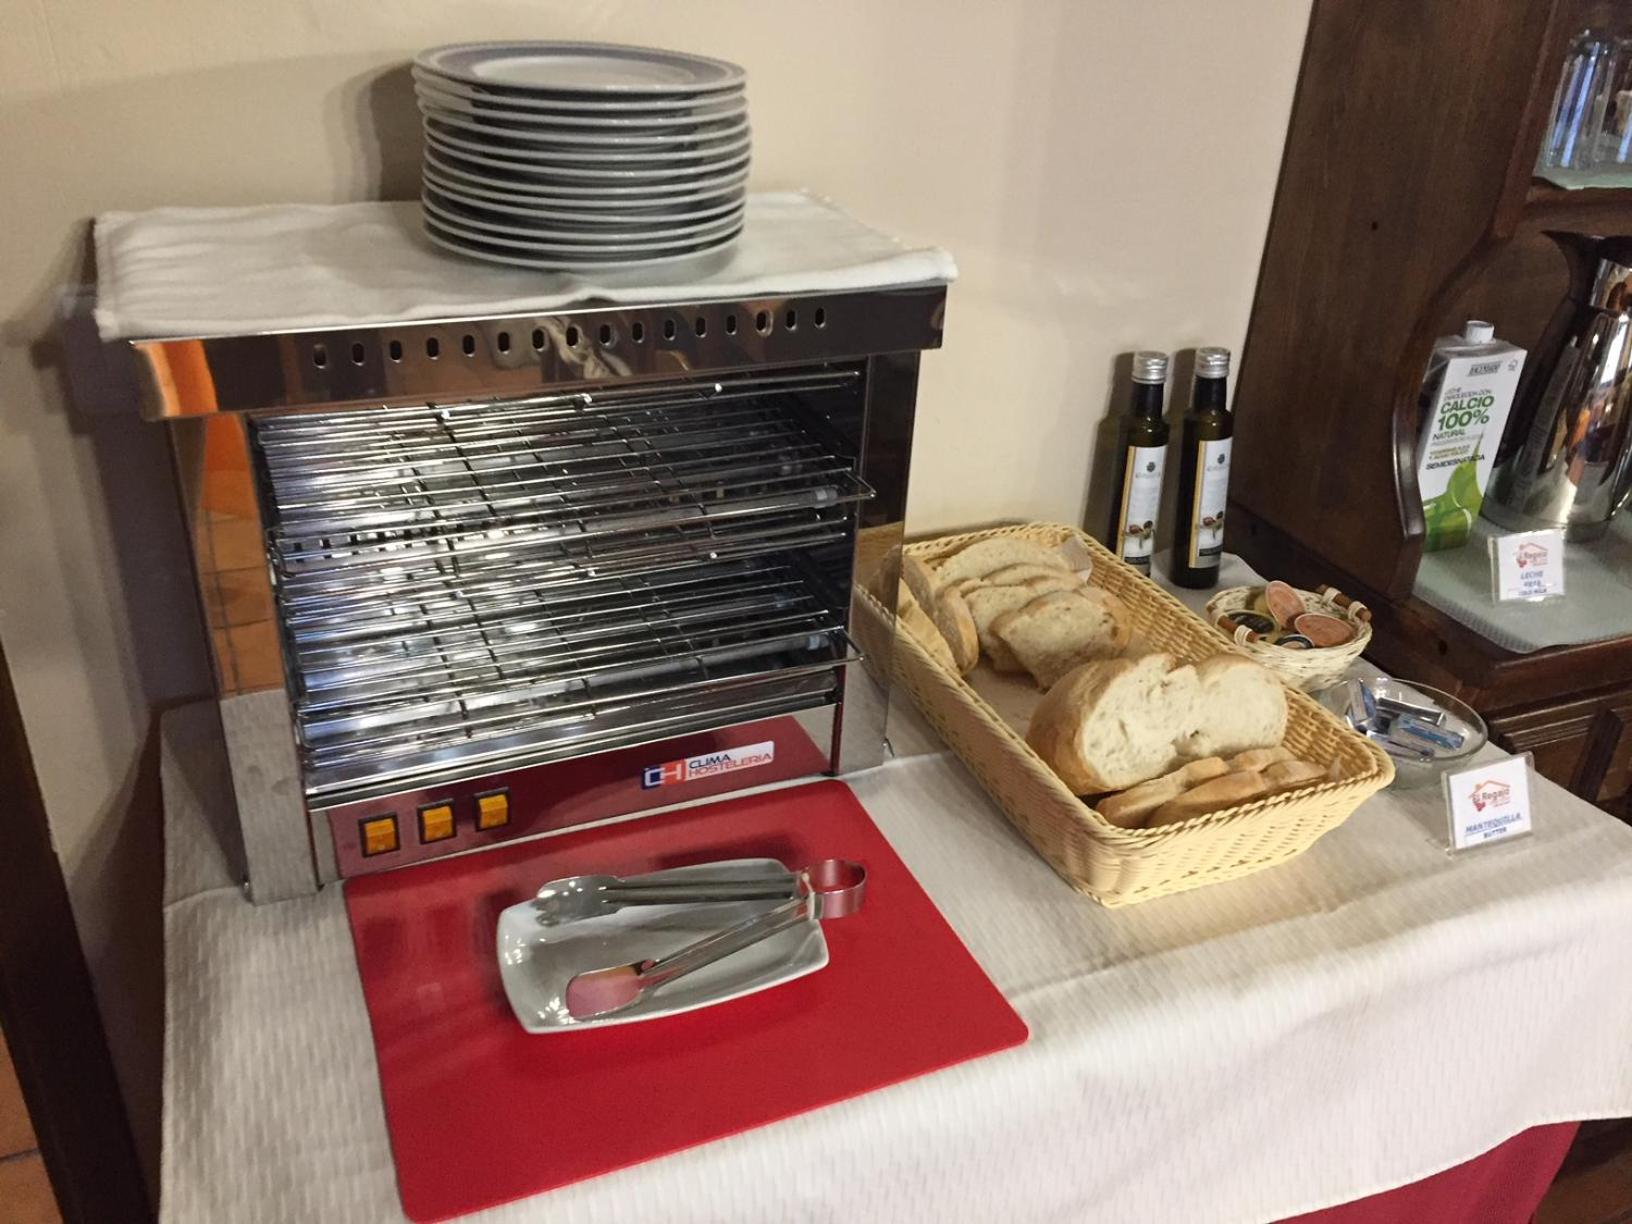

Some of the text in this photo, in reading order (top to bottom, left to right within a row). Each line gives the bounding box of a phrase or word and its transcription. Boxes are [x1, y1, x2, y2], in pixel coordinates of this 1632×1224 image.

[1440, 395, 1494, 414] CALCIO
[1438, 408, 1489, 431] 100%
[1432, 428, 1465, 441] NATURAL
[1520, 570, 1543, 580] LECHE
[688, 753, 731, 769] CLIMA
[688, 752, 773, 778] HOSTELERIA
[1465, 812, 1522, 832] MANTEQUILLA
[1483, 826, 1507, 839] BUTTER
